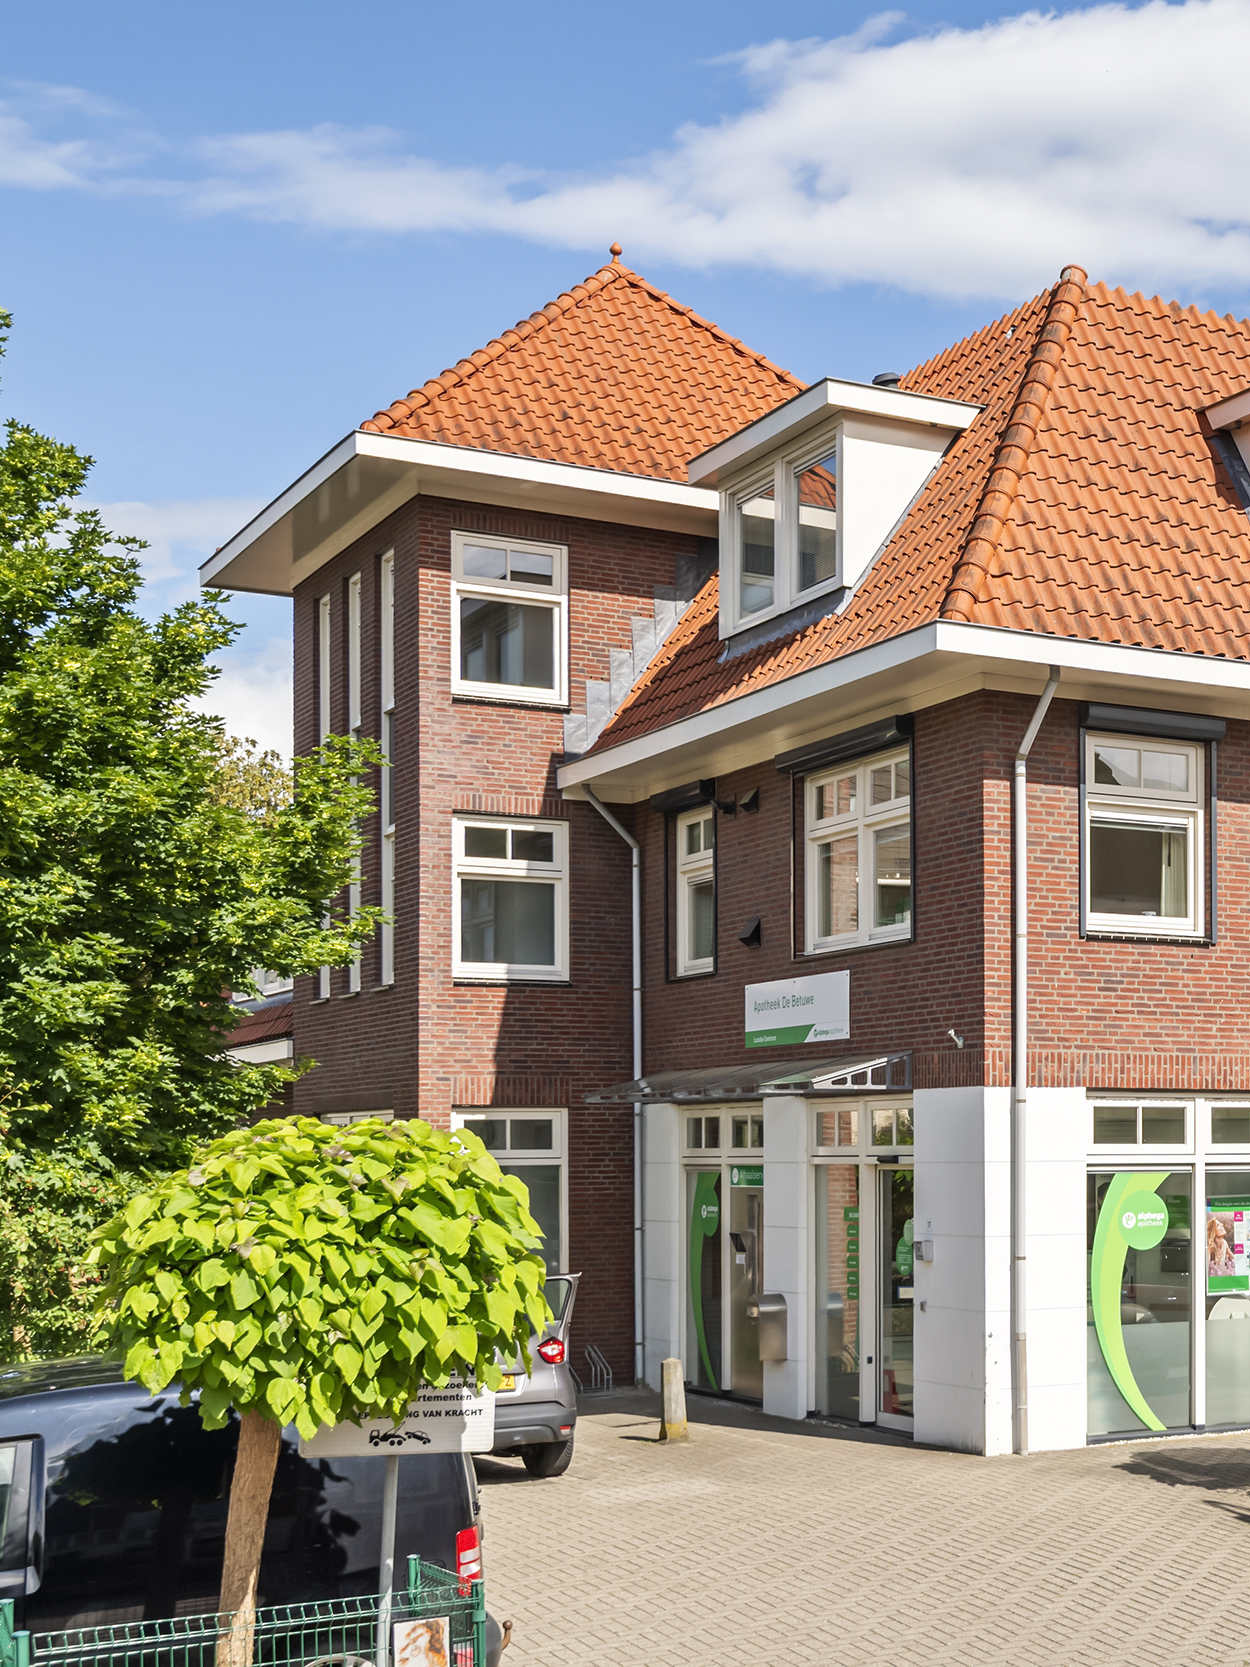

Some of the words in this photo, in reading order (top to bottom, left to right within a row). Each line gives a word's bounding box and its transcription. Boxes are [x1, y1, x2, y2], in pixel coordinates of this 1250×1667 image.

[753, 997, 781, 1014] Apotheek
[781, 995, 790, 1009] De
[791, 994, 814, 1007] Betuwe
[1137, 1212, 1165, 1220] alphega
[1137, 1220, 1163, 1228] apotheek
[422, 1411, 443, 1419] VAN
[445, 1409, 483, 1417] KRACHT
